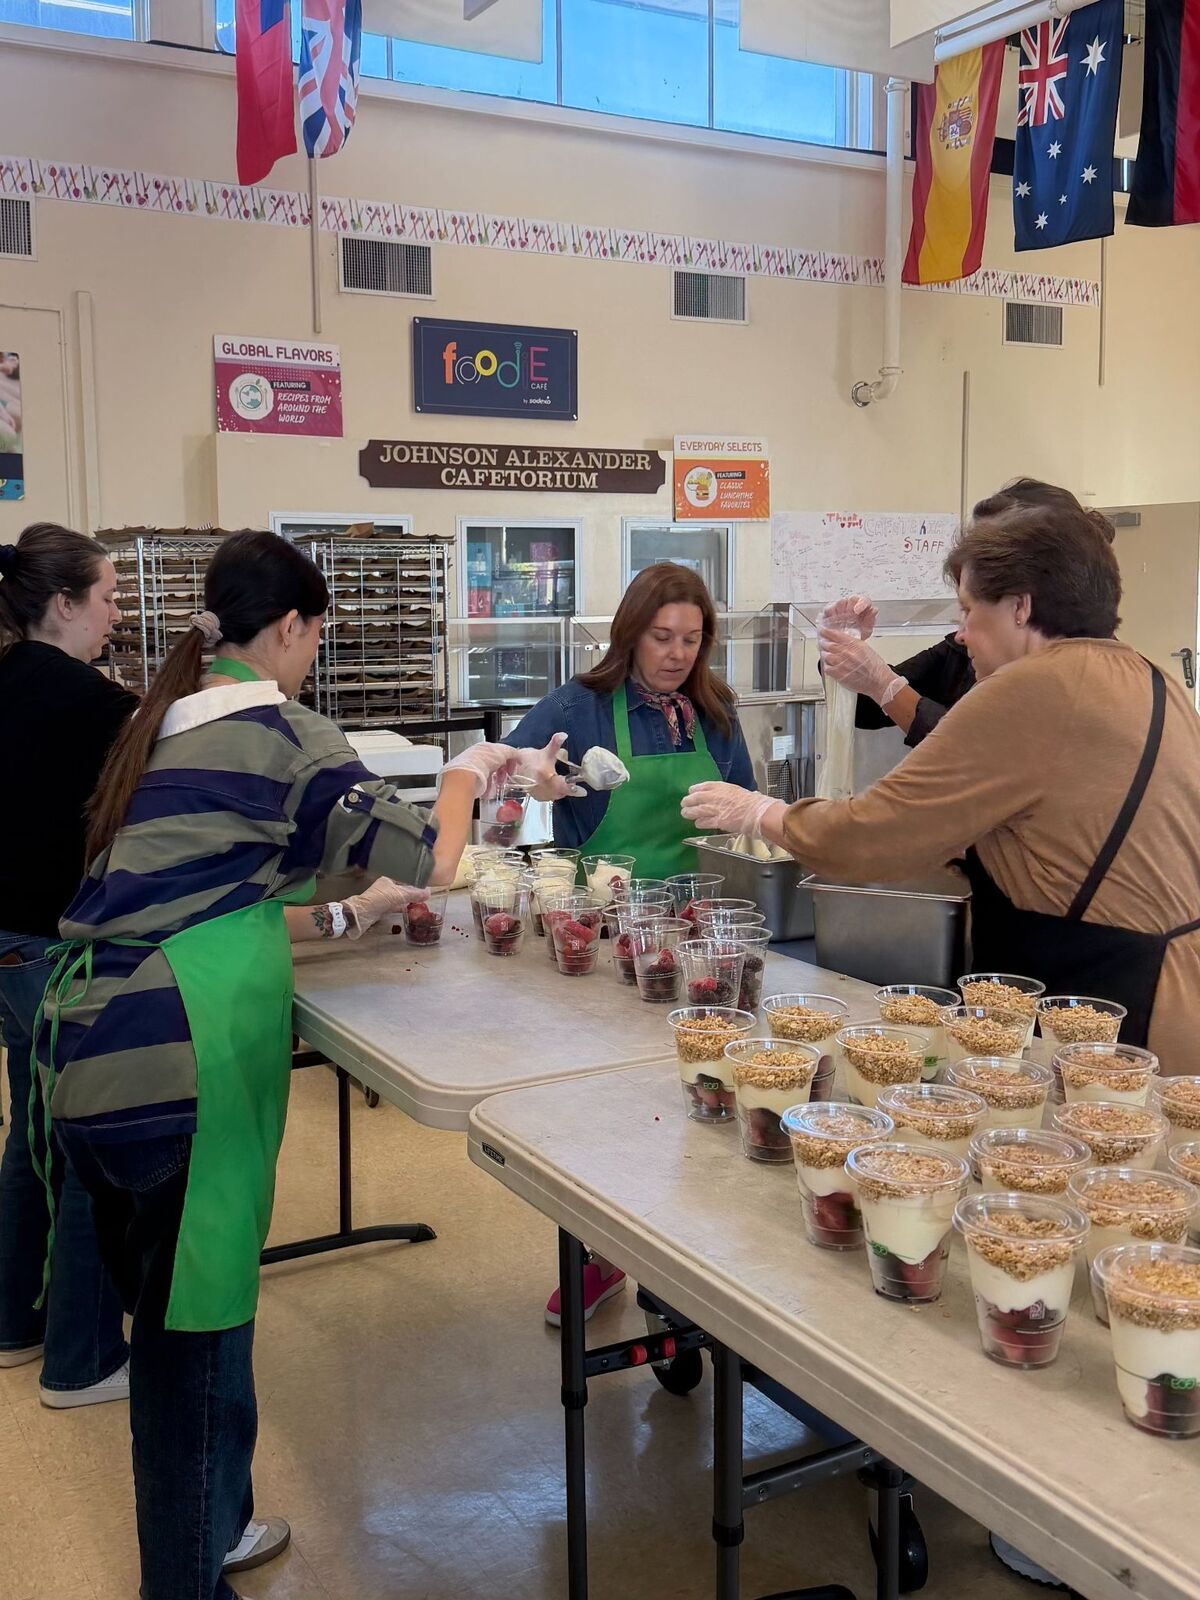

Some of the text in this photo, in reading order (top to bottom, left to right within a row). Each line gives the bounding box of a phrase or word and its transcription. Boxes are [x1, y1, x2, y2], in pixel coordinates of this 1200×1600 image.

[222, 342, 333, 363] GLOBAL FLAVORS
[272, 381, 306, 389] FEATURING
[277, 392, 332, 405] RECIPES FROM
[529, 396, 551, 405] sodexo
[277, 403, 327, 414] AROUND THE
[278, 414, 305, 424] WORLD
[680, 441, 762, 452] EVERYDAY SELECTS
[379, 444, 652, 471] JOHNSON ALEXANDER
[440, 468, 599, 489] CAFETORIUM
[719, 481, 744, 490] CLASSIC
[719, 491, 754, 500] LUNCHTIME
[720, 500, 751, 509] FAVORITES
[826, 512, 860, 523] Thank
[903, 536, 945, 554] STAFF
